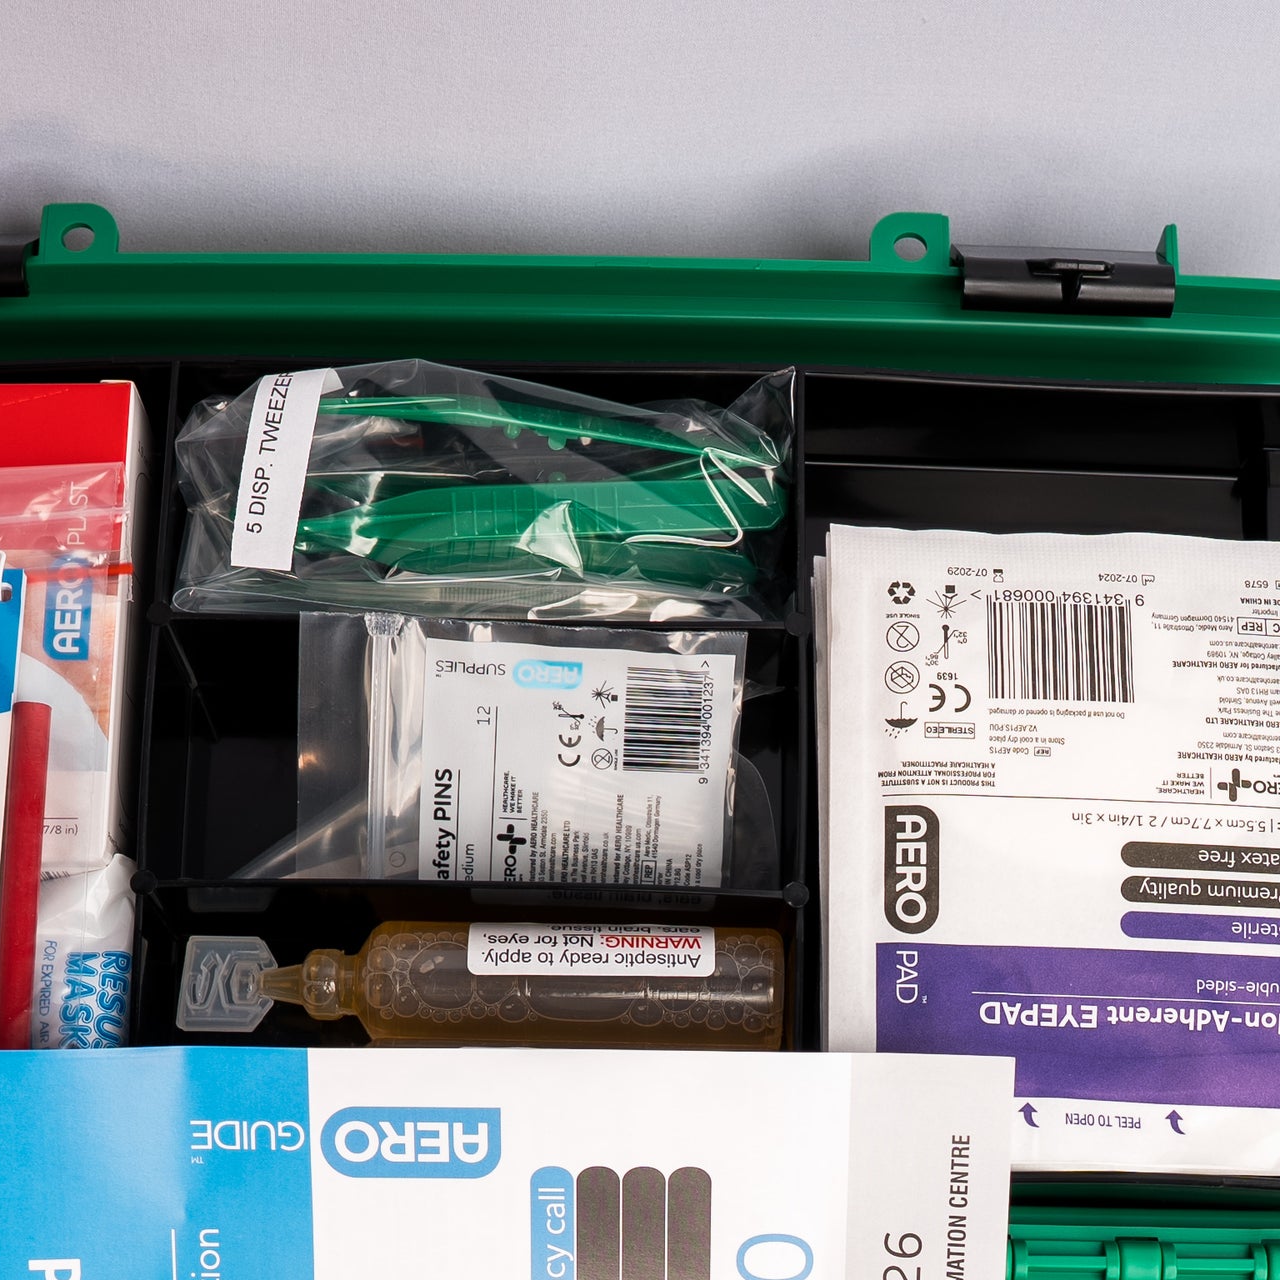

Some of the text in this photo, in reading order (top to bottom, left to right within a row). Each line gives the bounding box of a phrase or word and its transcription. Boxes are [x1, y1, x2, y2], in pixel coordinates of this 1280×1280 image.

[248, 464, 272, 515] DISP.
[246, 522, 262, 533] 5
[947, 566, 987, 576] 07-2029
[1098, 573, 1137, 582] 07-2024
[1244, 580, 1268, 588] 6578
[992, 589, 1058, 606] 000681
[1059, 591, 1126, 608] 341394
[435, 660, 505, 677] SUPPLIES
[518, 666, 578, 683] AERO
[476, 705, 490, 725] 12
[433, 768, 452, 820] PINS
[1072, 812, 1092, 824] 3in
[1097, 813, 1104, 821] x
[1108, 814, 1142, 826] 1/4in
[1149, 815, 1156, 827] 2
[1171, 817, 1211, 829] 7.7cm
[1226, 819, 1265, 832] 5.5cm
[1198, 849, 1235, 867] free
[894, 814, 928, 923] AERO
[1139, 877, 1201, 899] quality
[483, 932, 701, 950] WARNING: Not for eyes,
[481, 948, 701, 968] Antiseptic ready to apply.
[896, 950, 918, 1003] PAD
[40, 940, 57, 1043] FOR EXPIRED AIR
[59, 952, 100, 1048] MASK
[979, 1002, 1097, 1028] EYEPAD
[1065, 1113, 1141, 1129] PEEL TO OPEN
[190, 1120, 304, 1151] GUIDE
[334, 1120, 488, 1163] AERO
[948, 1135, 970, 1207] CENTRE
[538, 1188, 565, 1234] call
